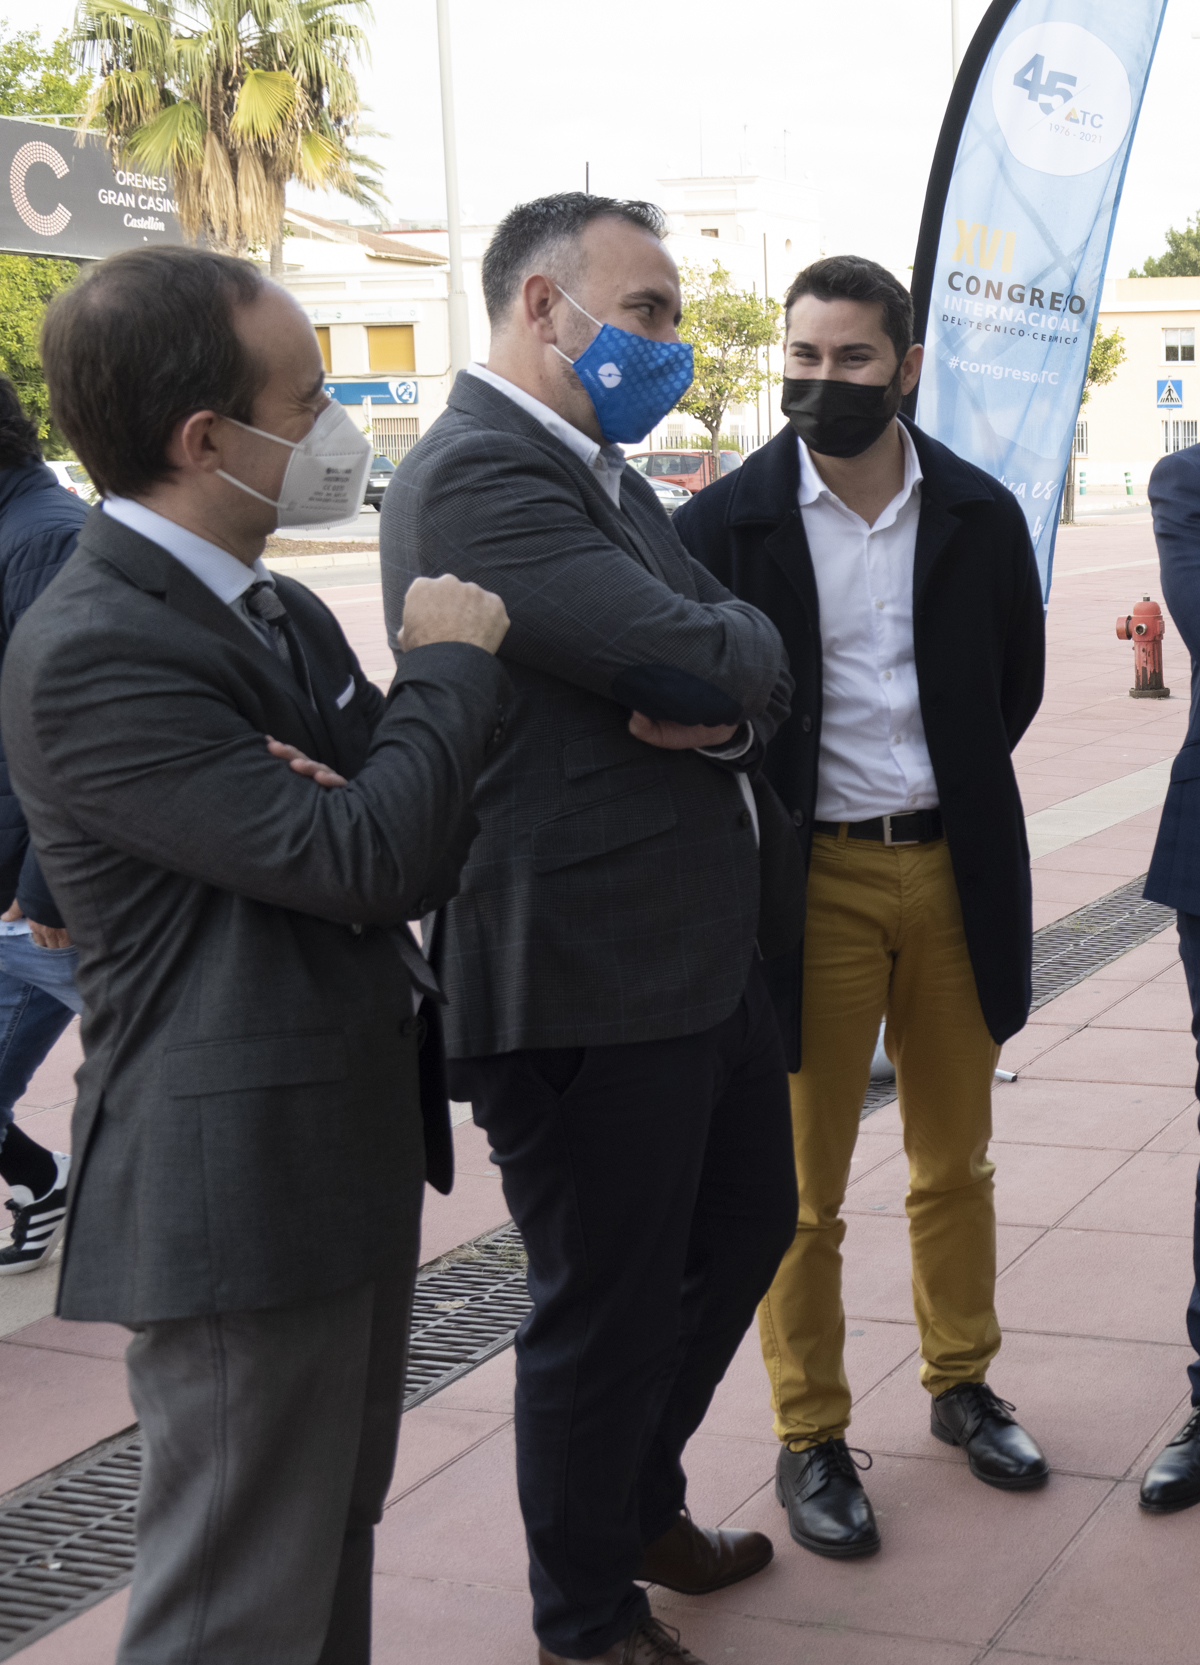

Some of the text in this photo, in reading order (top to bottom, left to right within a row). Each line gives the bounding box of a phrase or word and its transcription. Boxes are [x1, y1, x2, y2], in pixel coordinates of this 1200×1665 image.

[1013, 53, 1077, 116] 45
[1065, 107, 1104, 129] ATC
[1049, 122, 1070, 137] 1976
[1079, 131, 1102, 144] 2021
[116, 170, 167, 192] ORENES
[98, 188, 136, 208] GRAN
[123, 212, 166, 232] Castellón
[951, 218, 1017, 273] XVI
[947, 271, 1086, 315] CONGREO
[943, 294, 1081, 333] INTERNACIOAL
[1031, 480, 1059, 501] es
